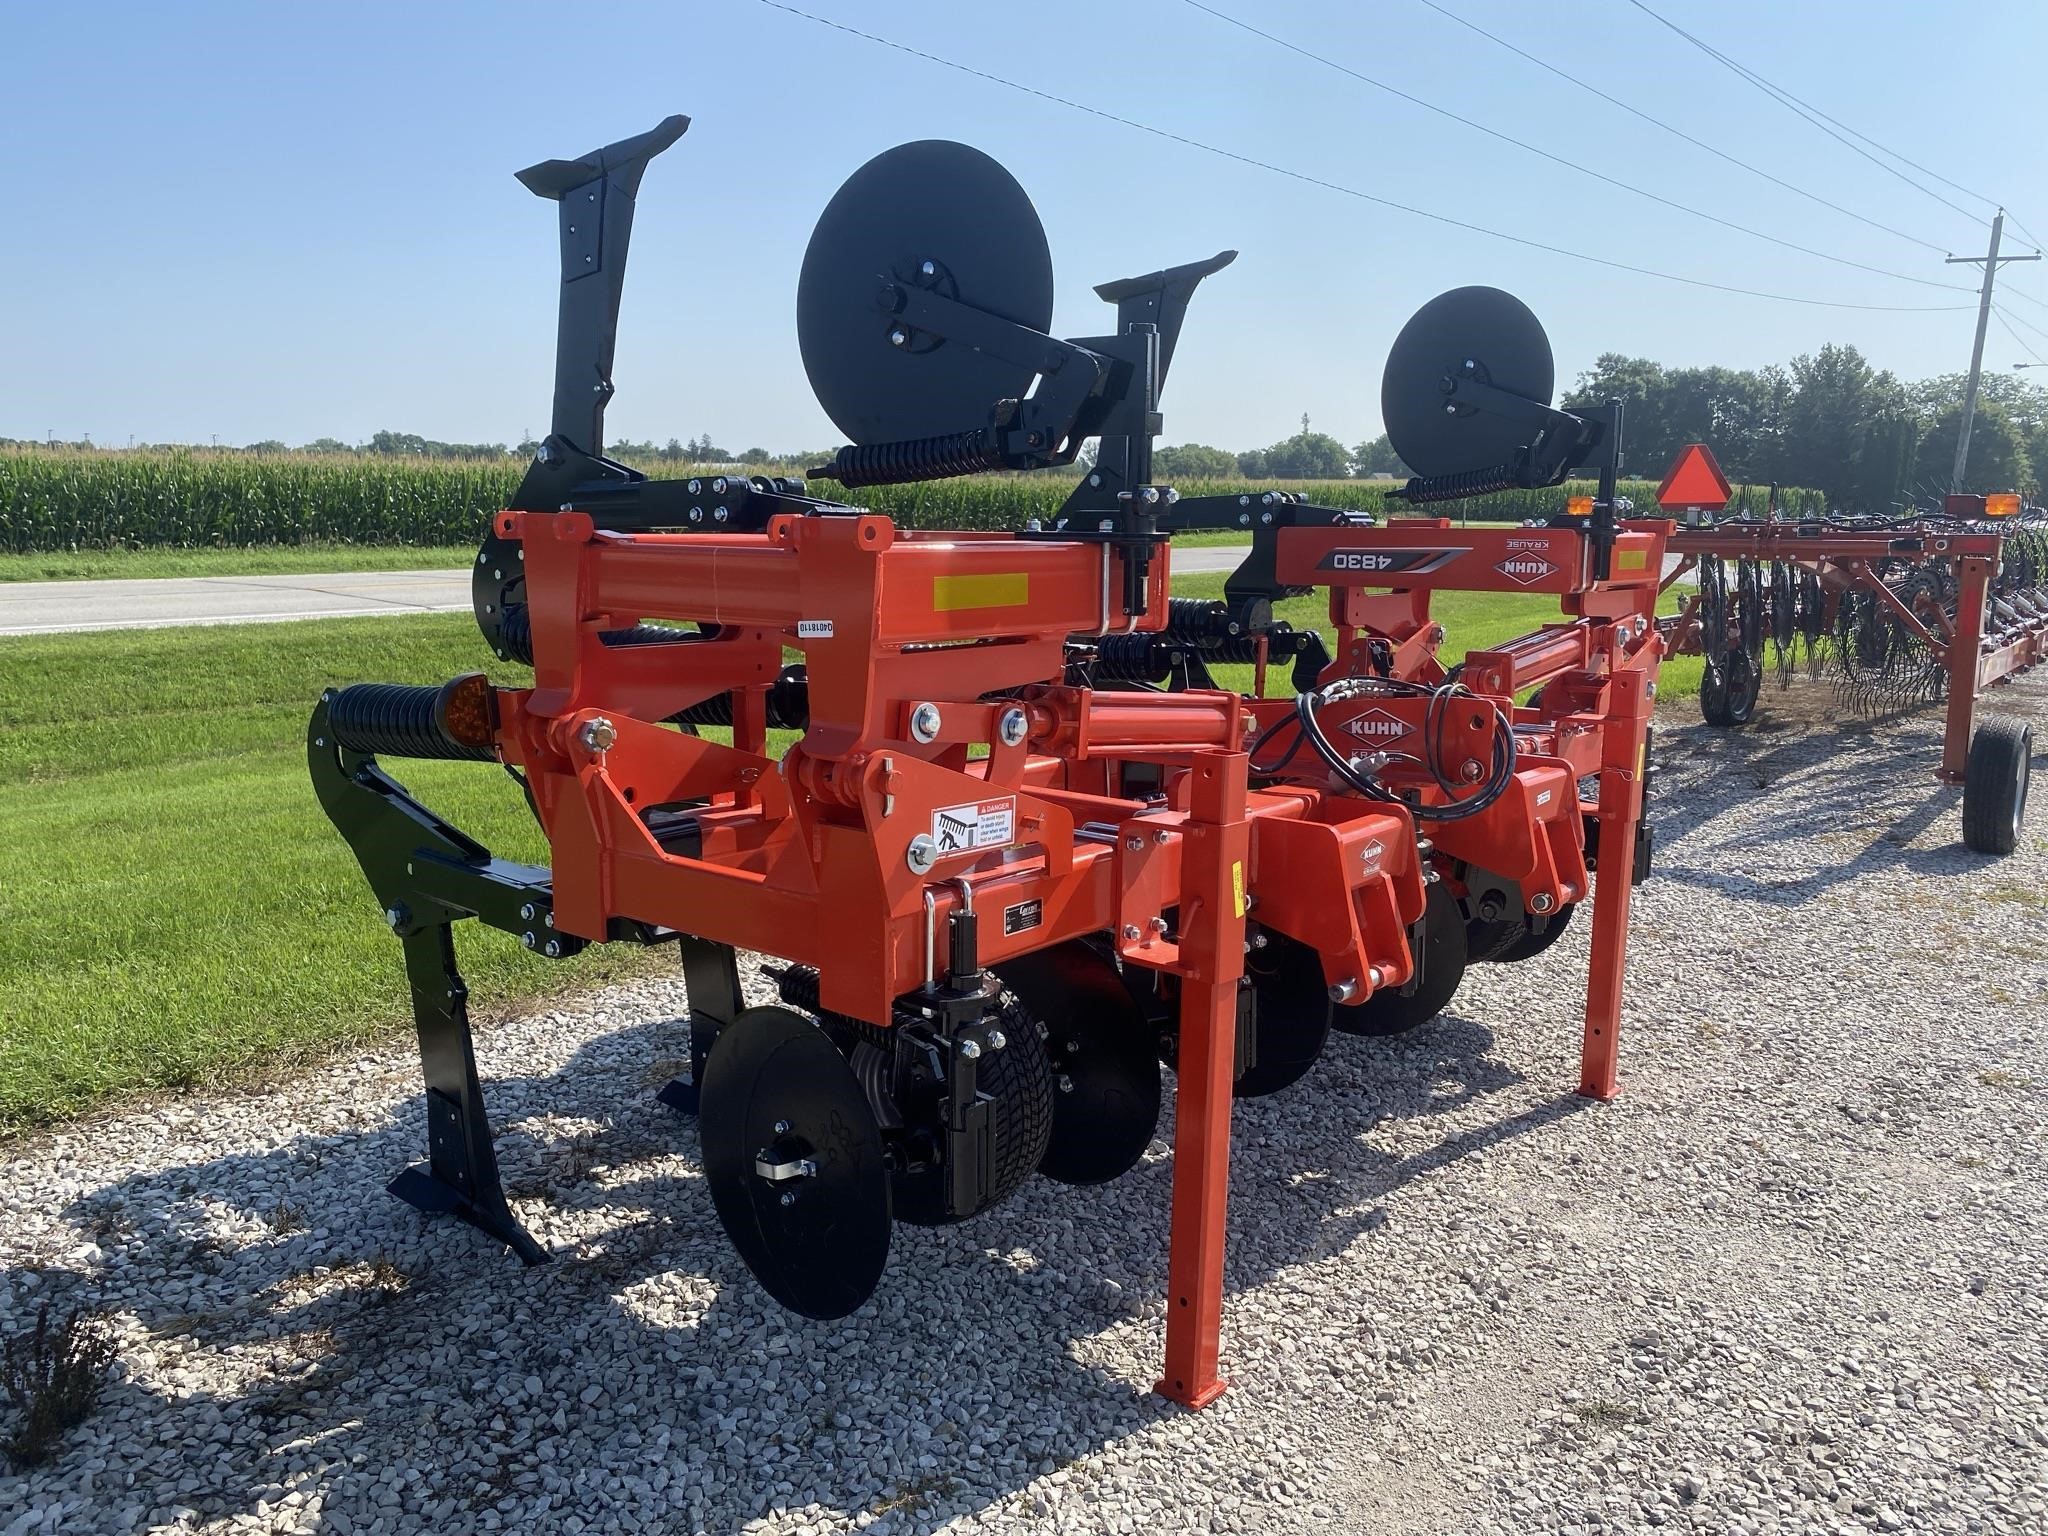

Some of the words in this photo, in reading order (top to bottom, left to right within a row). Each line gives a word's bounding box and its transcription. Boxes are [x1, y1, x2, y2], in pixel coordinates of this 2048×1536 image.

[1506, 541, 1549, 549] KRAUSE
[1333, 554, 1392, 570] 4830
[1504, 561, 1548, 574] KUHN
[1351, 721, 1403, 735] KUHN
[987, 803, 1009, 812] DANGER
[1364, 845, 1382, 859] KUHN
